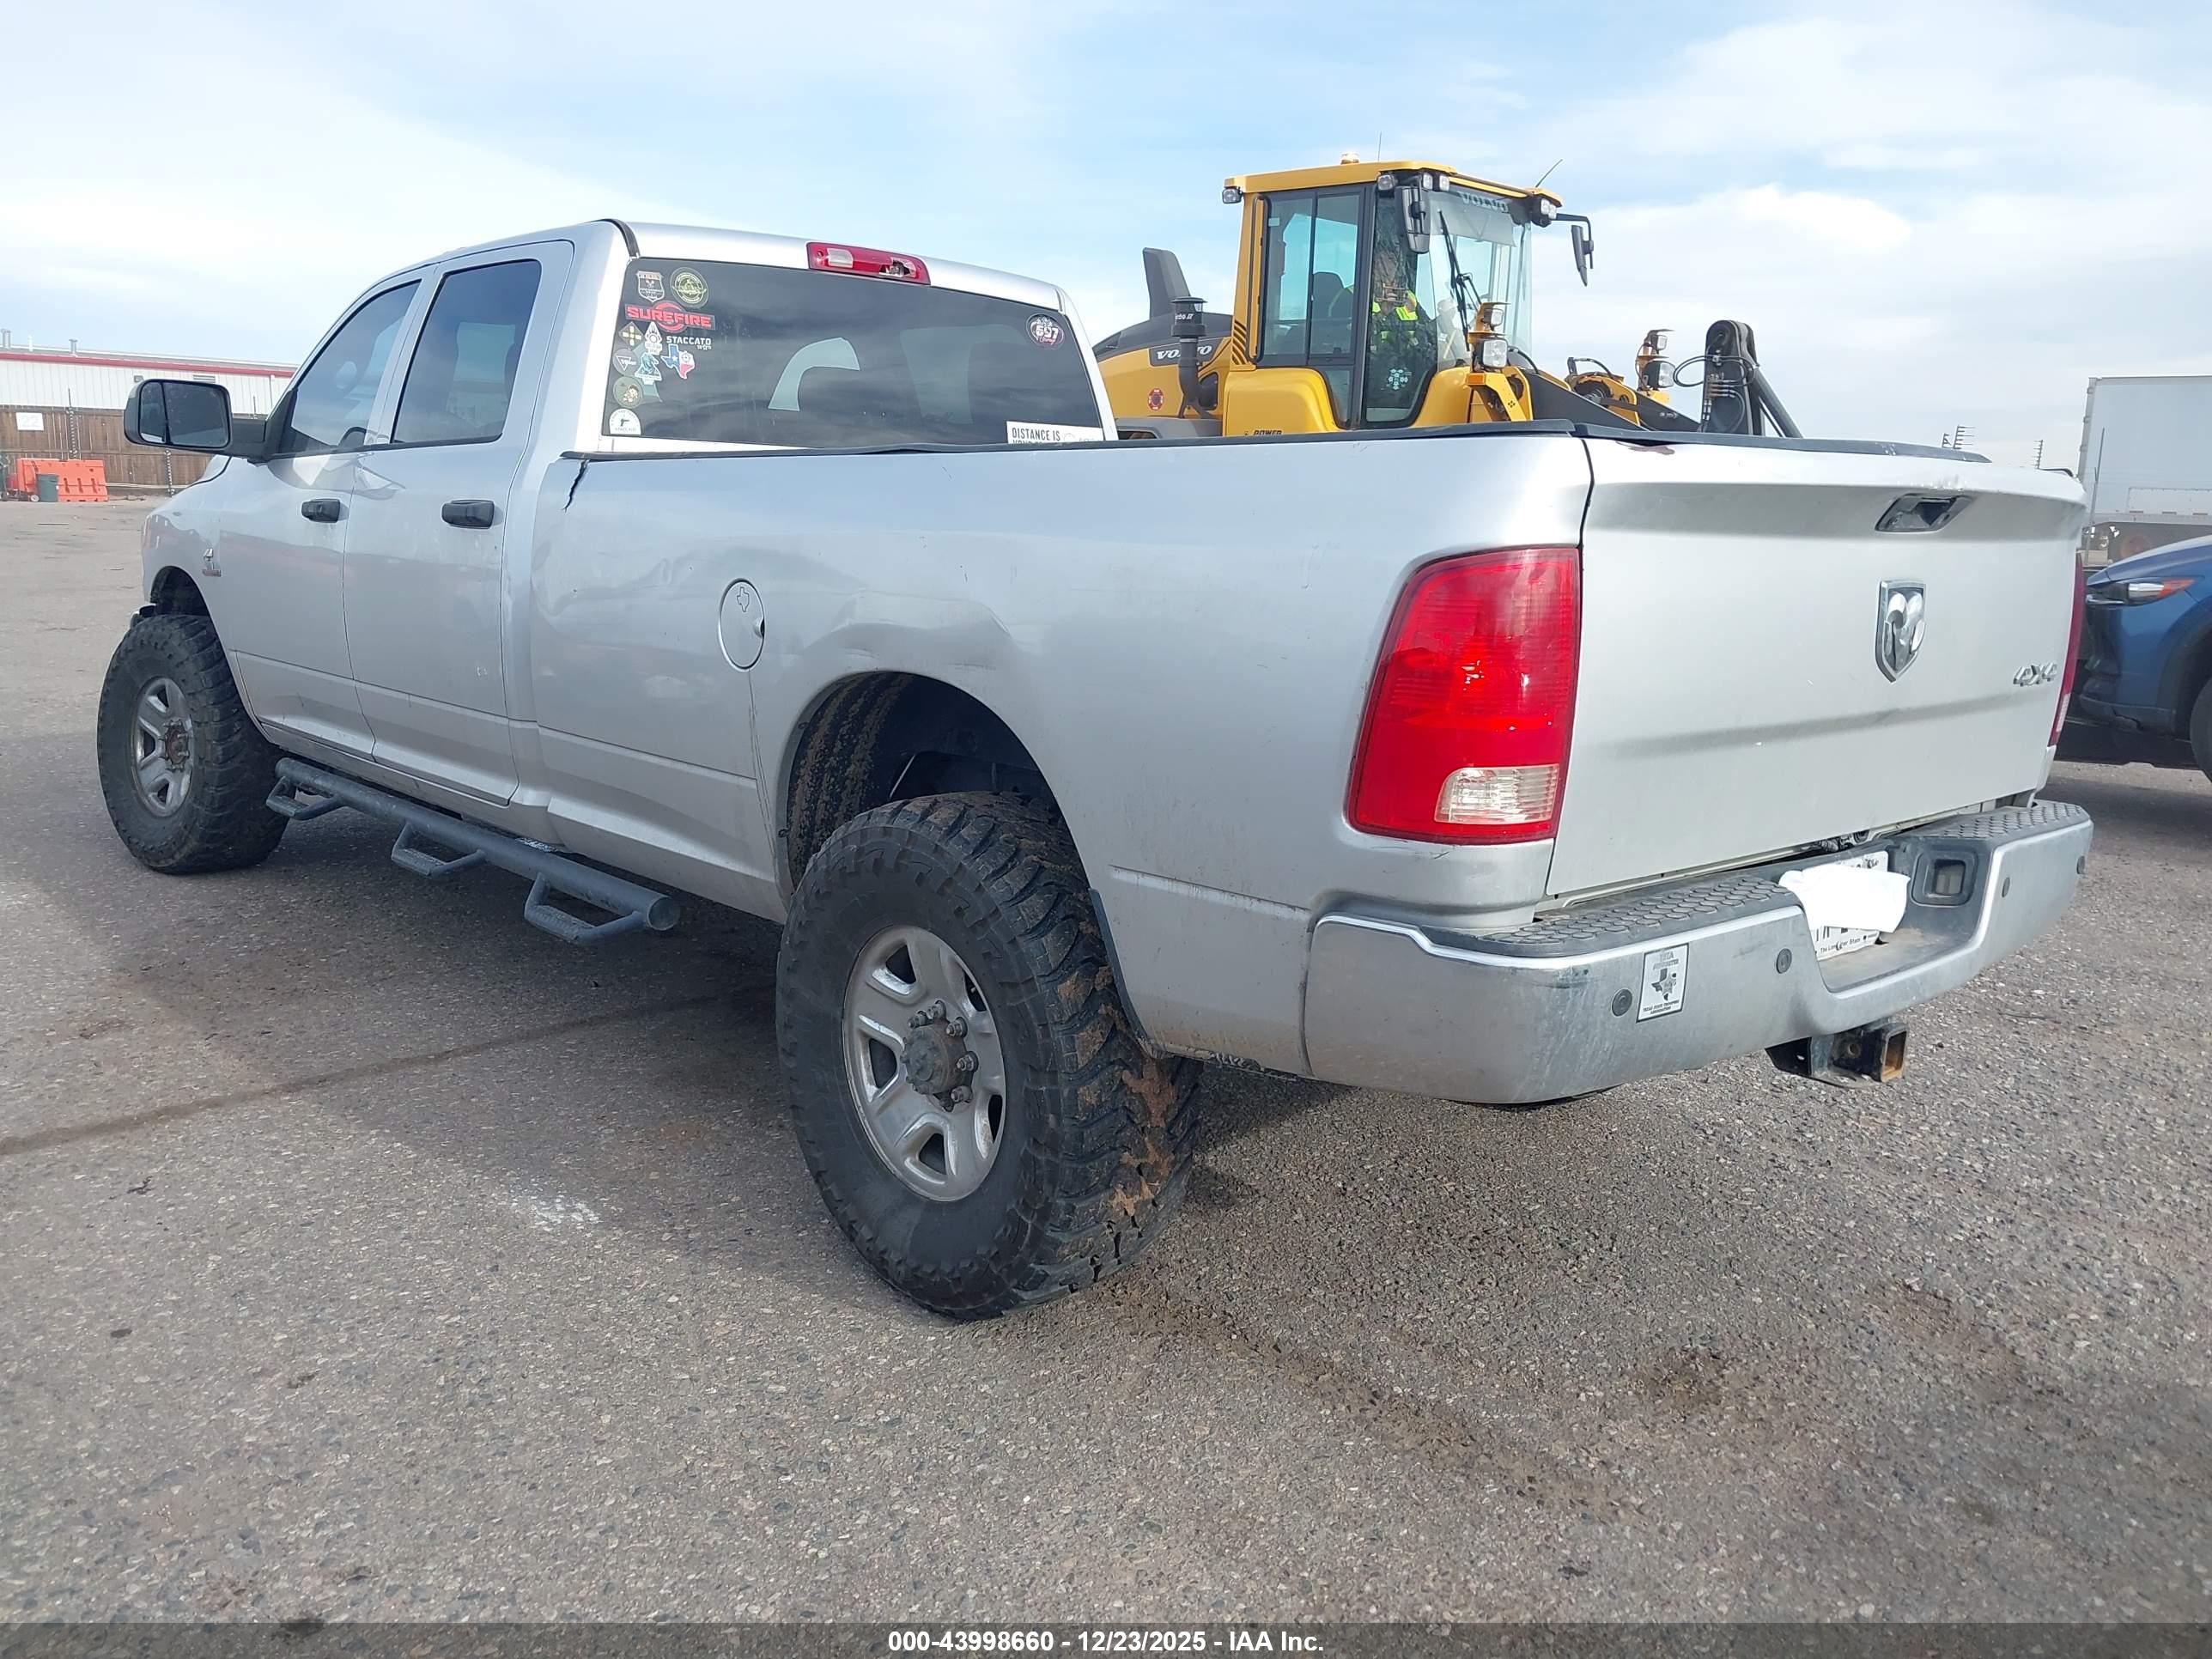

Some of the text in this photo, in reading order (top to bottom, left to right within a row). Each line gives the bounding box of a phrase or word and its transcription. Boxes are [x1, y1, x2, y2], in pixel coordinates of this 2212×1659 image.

[1457, 191, 1509, 213] VOLVO
[627, 306, 712, 328] SUREFIRE
[666, 336, 712, 345] STACCATO
[1012, 428, 1060, 441] DISTANCE IS
